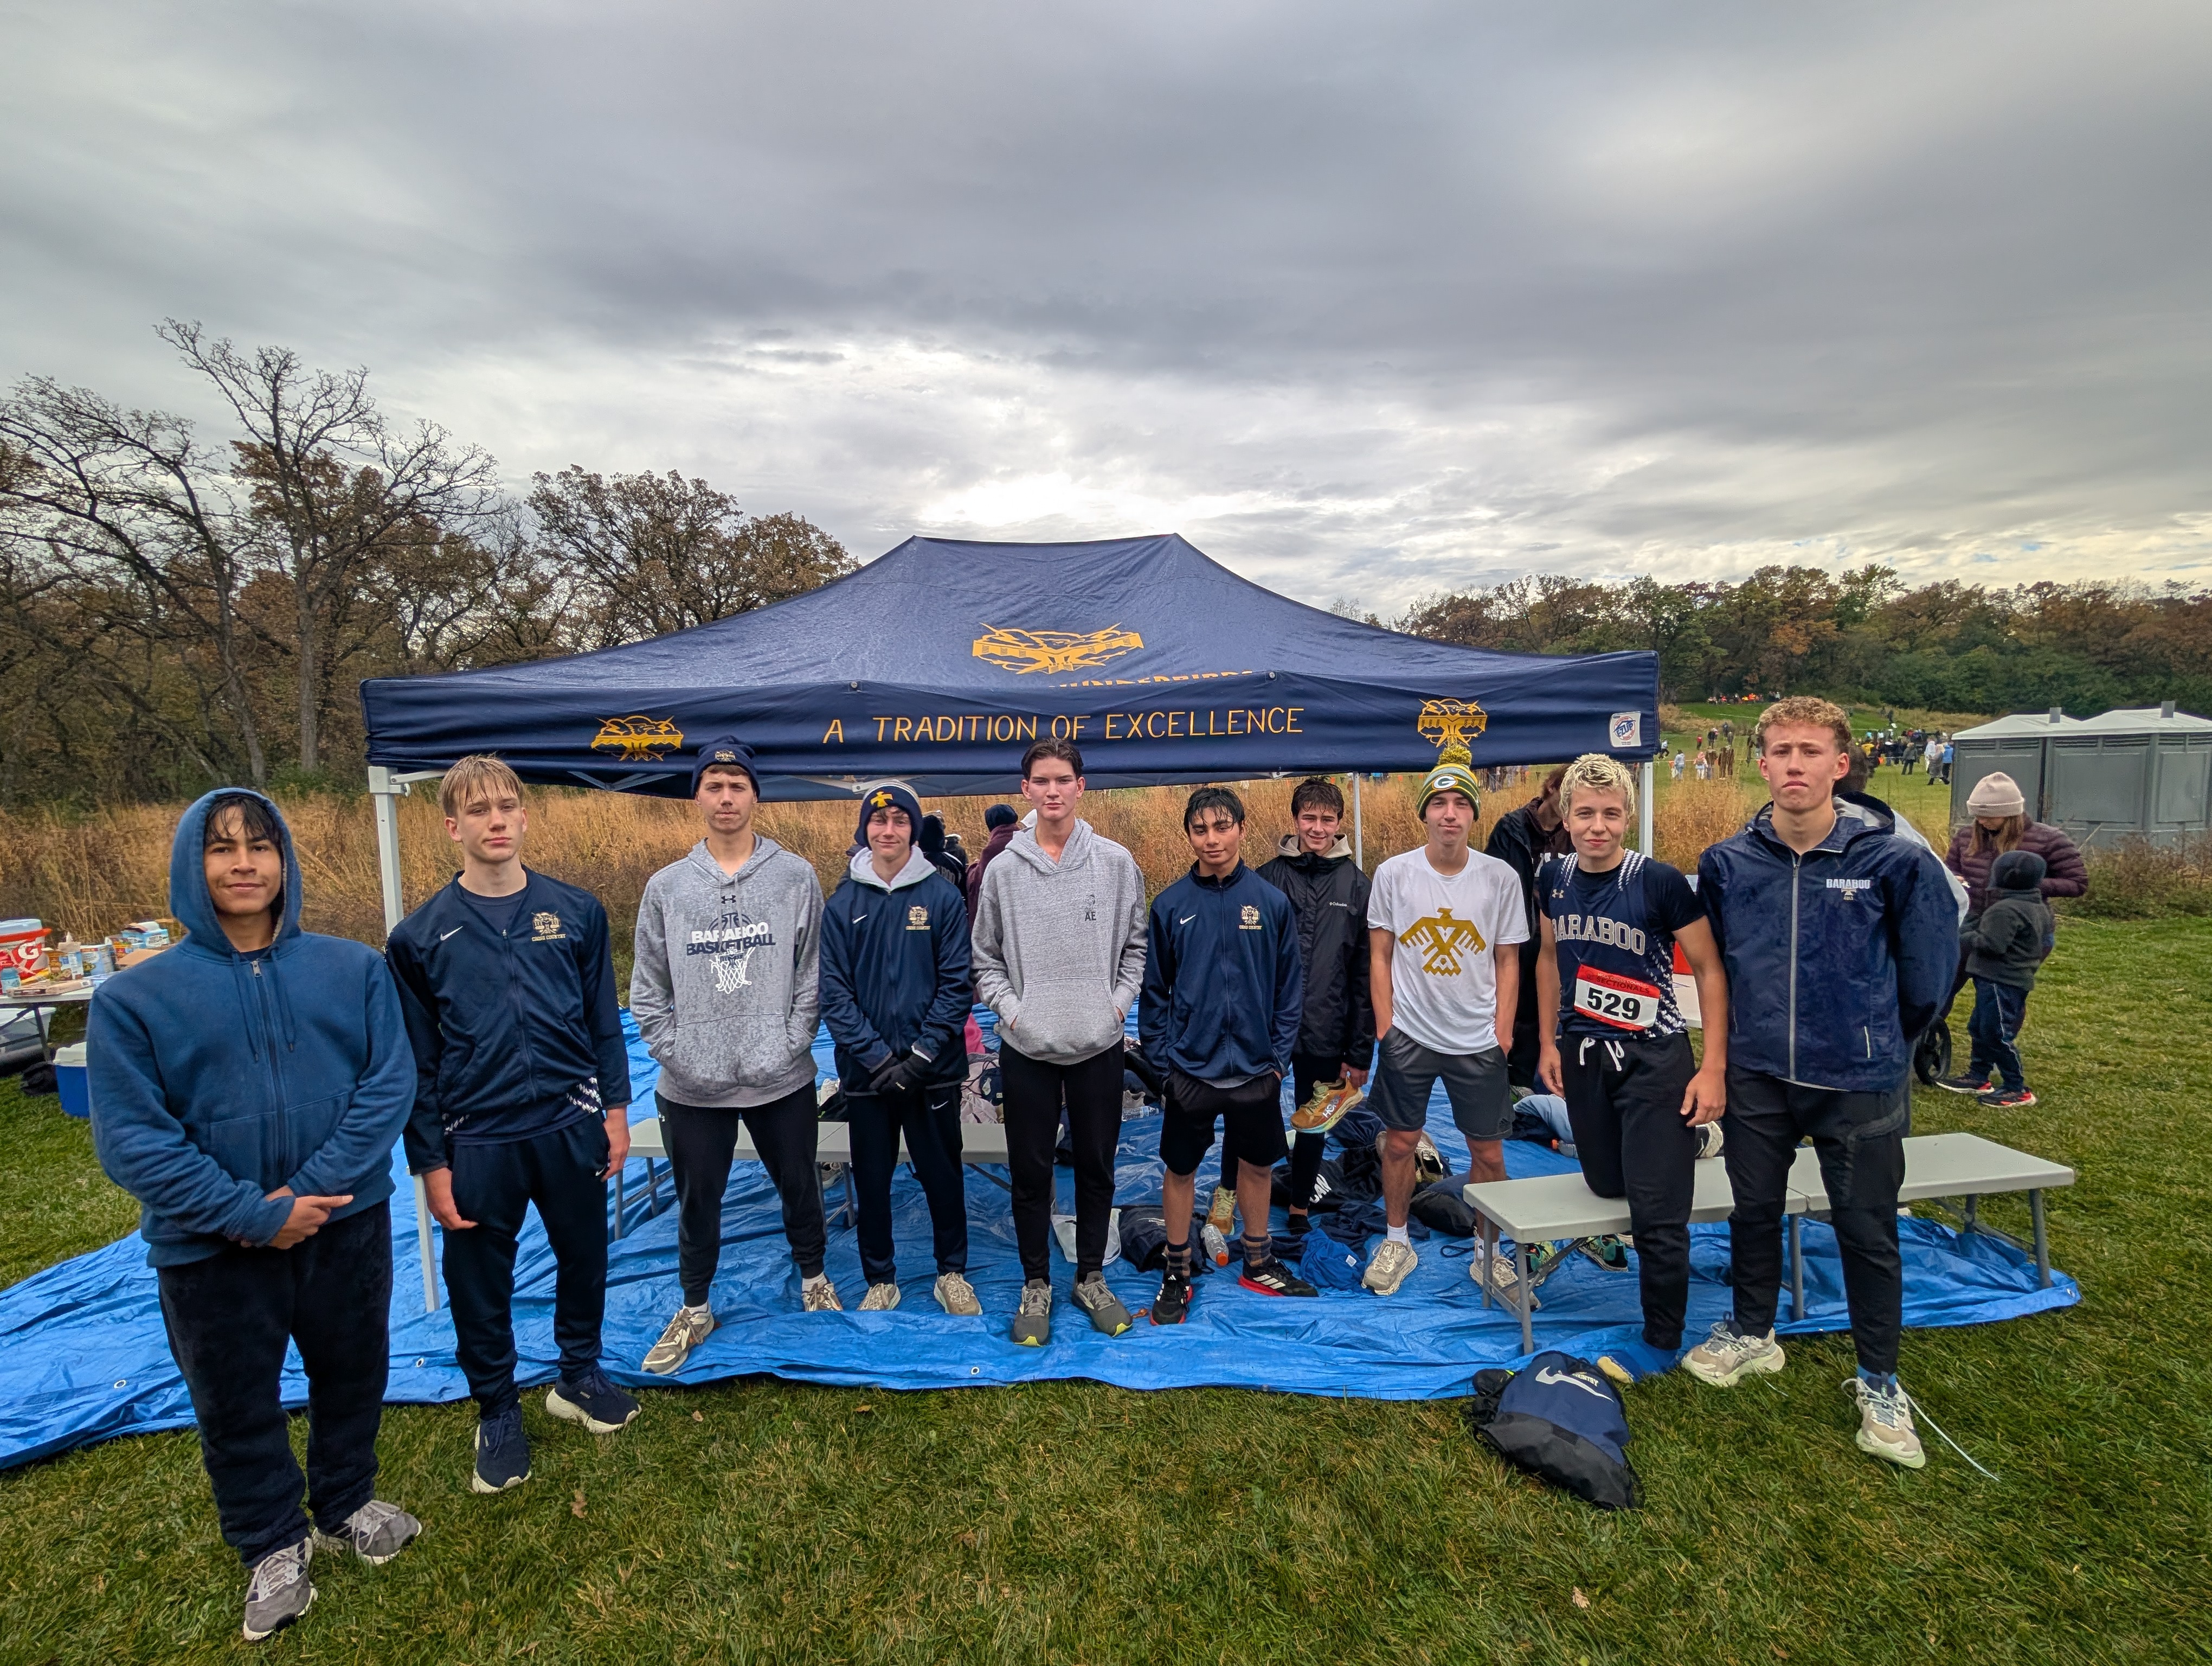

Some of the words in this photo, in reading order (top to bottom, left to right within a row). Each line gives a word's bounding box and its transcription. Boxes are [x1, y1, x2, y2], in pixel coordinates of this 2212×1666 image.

[823, 719, 844, 744] A
[872, 715, 1037, 743] TRADITION
[1052, 715, 1091, 740] OF
[1105, 707, 1305, 739] EXCELLENCE
[1433, 776, 1456, 789] G
[1826, 879, 1870, 889] BARABOO
[691, 921, 769, 944] BARABOO
[18, 941, 40, 959] G
[686, 933, 776, 956] BASKETBALL
[1596, 977, 1650, 994] SECTIONALS
[1586, 986, 1641, 1021] 529
